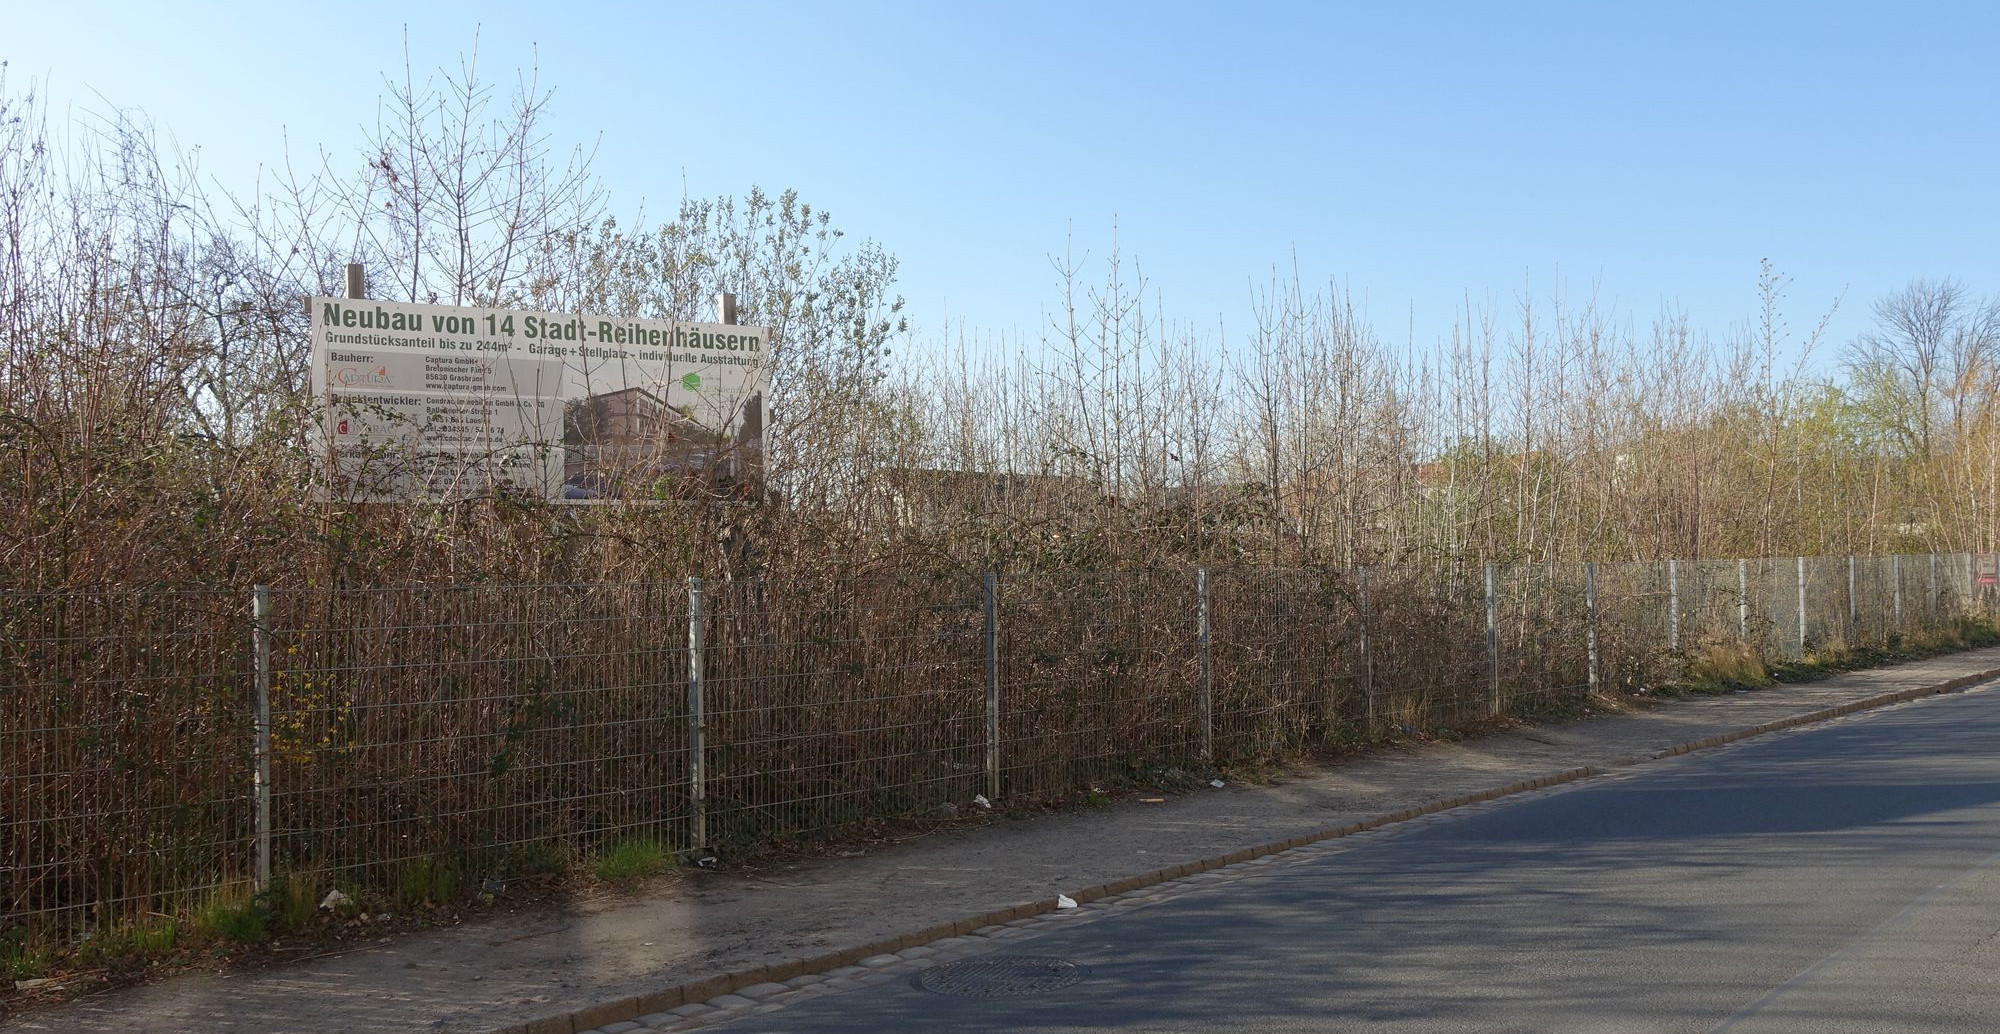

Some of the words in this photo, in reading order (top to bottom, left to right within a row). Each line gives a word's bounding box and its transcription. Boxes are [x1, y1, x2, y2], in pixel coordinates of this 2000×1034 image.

[324, 303, 422, 332] Neubau
[432, 315, 475, 334] von
[485, 313, 515, 337] 14
[524, 315, 760, 351] Stadt-Reihenhäusern
[326, 331, 435, 349] Grundstücksanteil
[439, 338, 456, 350] bis
[460, 341, 472, 351] zu
[476, 340, 513, 353] 244m²
[331, 352, 374, 363] Bauherr:
[425, 356, 453, 365] Captura
[487, 367, 492, 375] 5
[425, 373, 448, 381] 85630
[425, 383, 507, 392] www.captura-gmhcom
[457, 398, 493, 407] Immobilen
[495, 399, 515, 407] GmbH
[466, 417, 491, 425] Laus
[339, 424, 392, 434] CONRAC
